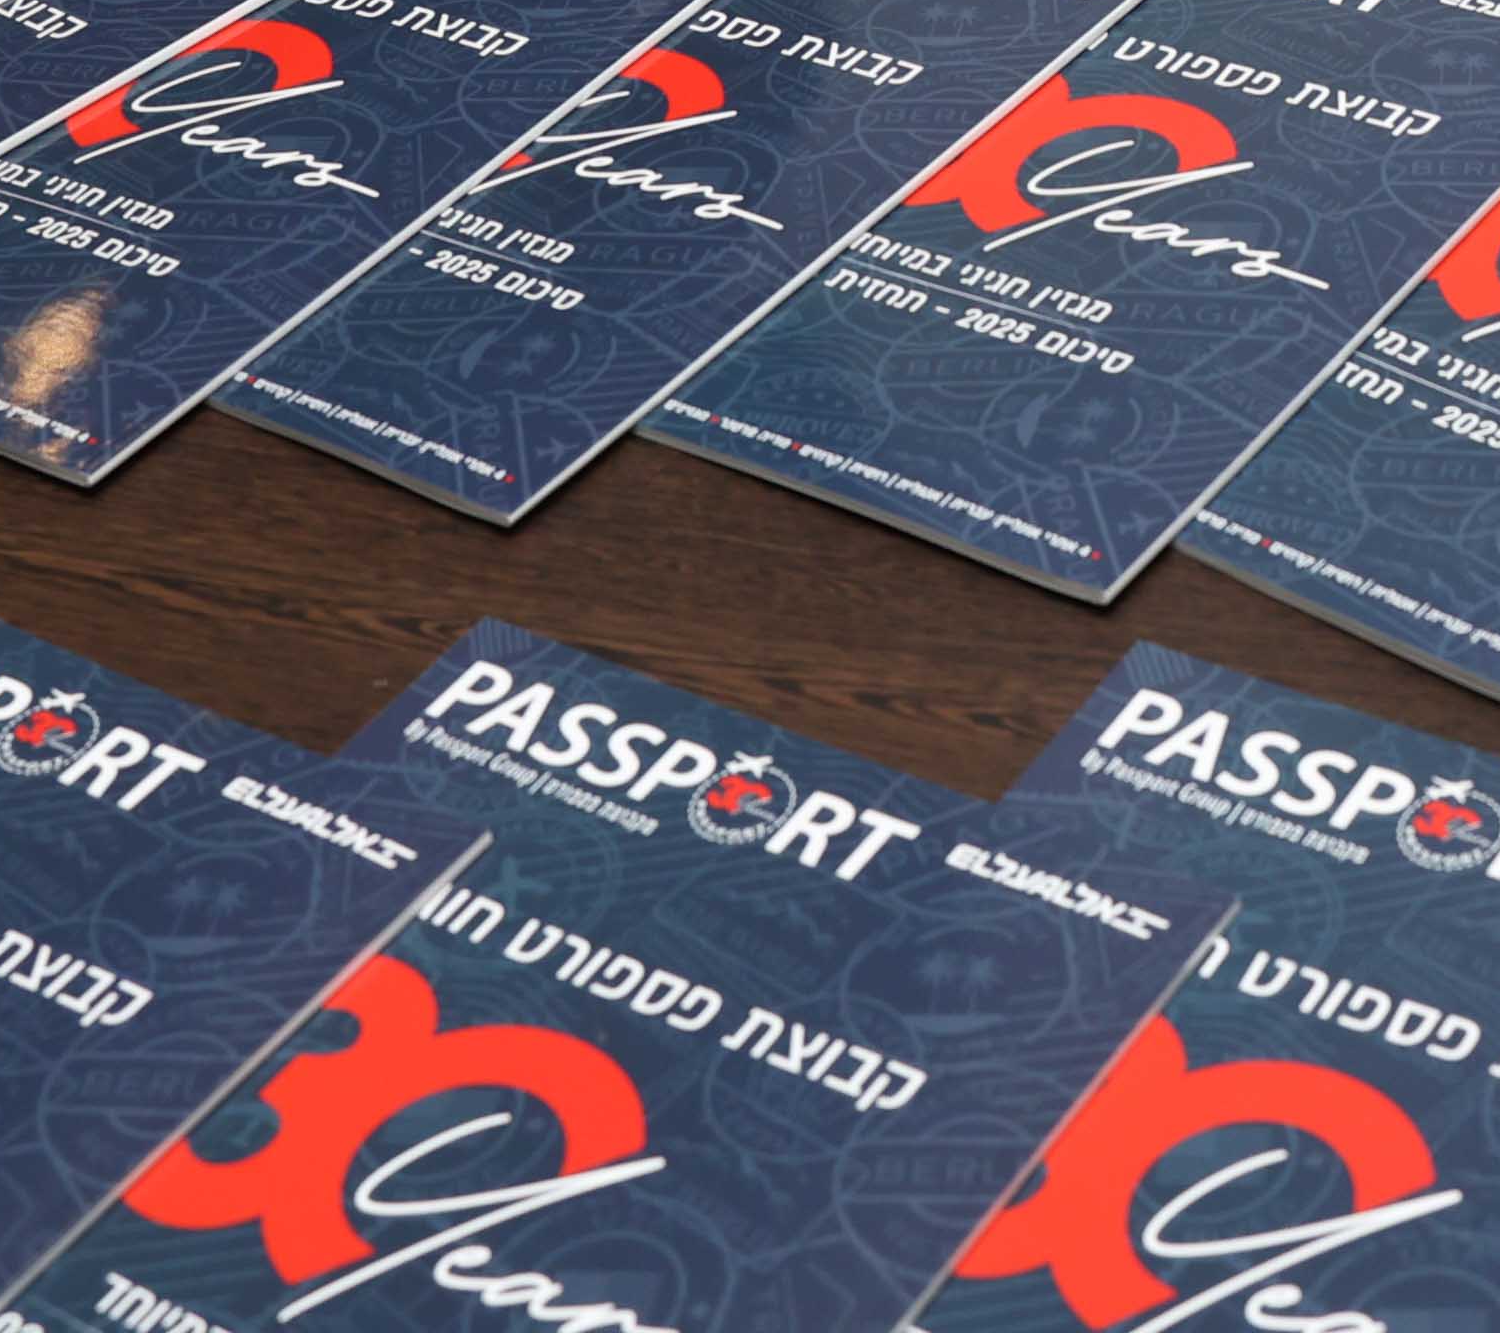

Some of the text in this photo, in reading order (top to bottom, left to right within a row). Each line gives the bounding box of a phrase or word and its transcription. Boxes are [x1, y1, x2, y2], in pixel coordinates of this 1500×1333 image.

[391, 8, 530, 59] קבוצת
[781, 33, 924, 87] קבוצת
[1114, 34, 1441, 139] קבוצת פספורט
[42, 174, 175, 230] מגזין חגיגי
[26, 216, 98, 249] 2025
[92, 237, 179, 276] סיכום
[497, 226, 575, 264] מגזין
[425, 249, 584, 311] סיכום 2025
[953, 263, 1034, 301] חגיגי
[1026, 284, 1112, 324] מגזין
[824, 265, 1134, 374] סיכום 2025 תחזית
[424, 659, 921, 884] PASSPORT
[501, 916, 928, 1116] קבוצת פספורט
[1237, 946, 1482, 1065] פספורט
